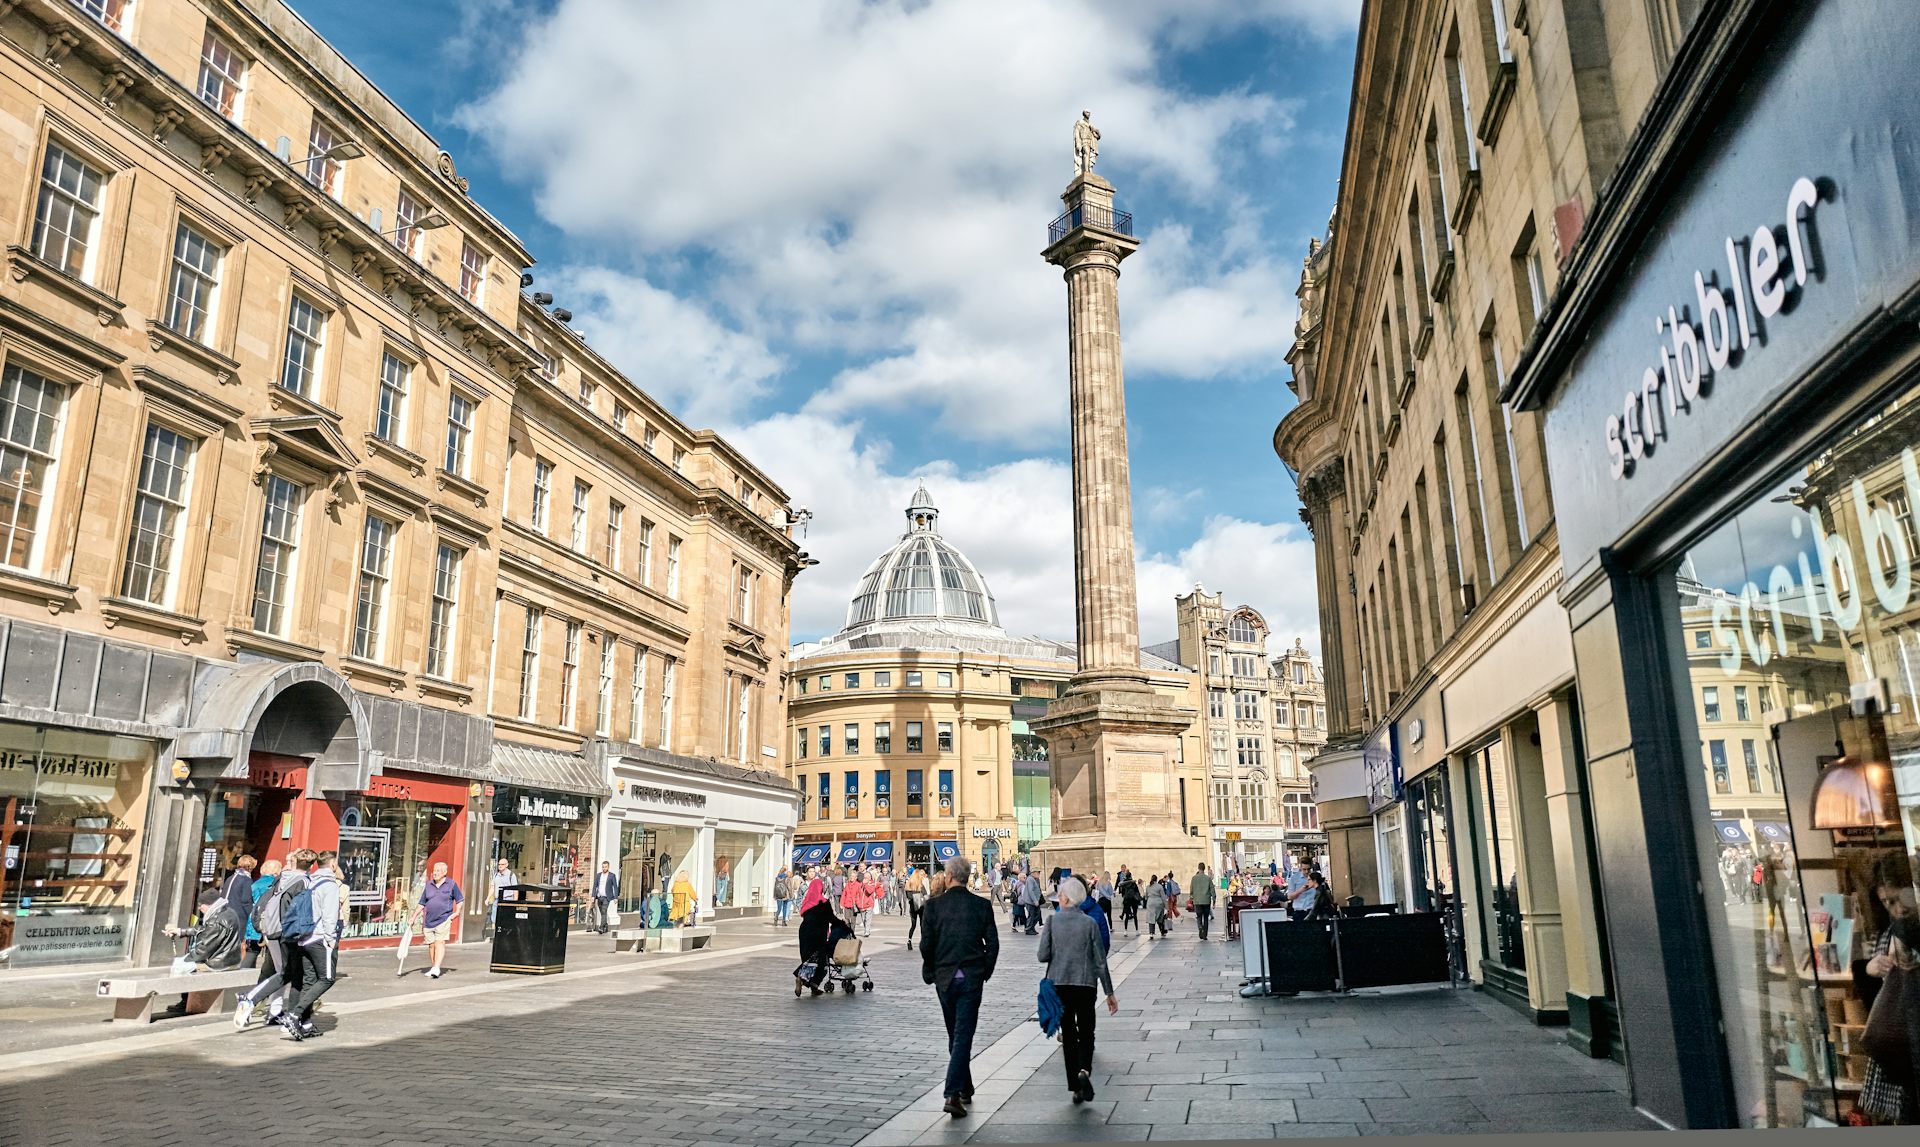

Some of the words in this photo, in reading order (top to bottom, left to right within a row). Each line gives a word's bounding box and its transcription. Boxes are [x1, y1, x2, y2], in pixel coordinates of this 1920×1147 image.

[1605, 177, 1818, 481] scribbler
[973, 826, 1011, 838] banyan
[25, 926, 91, 938] CELEBRATION
